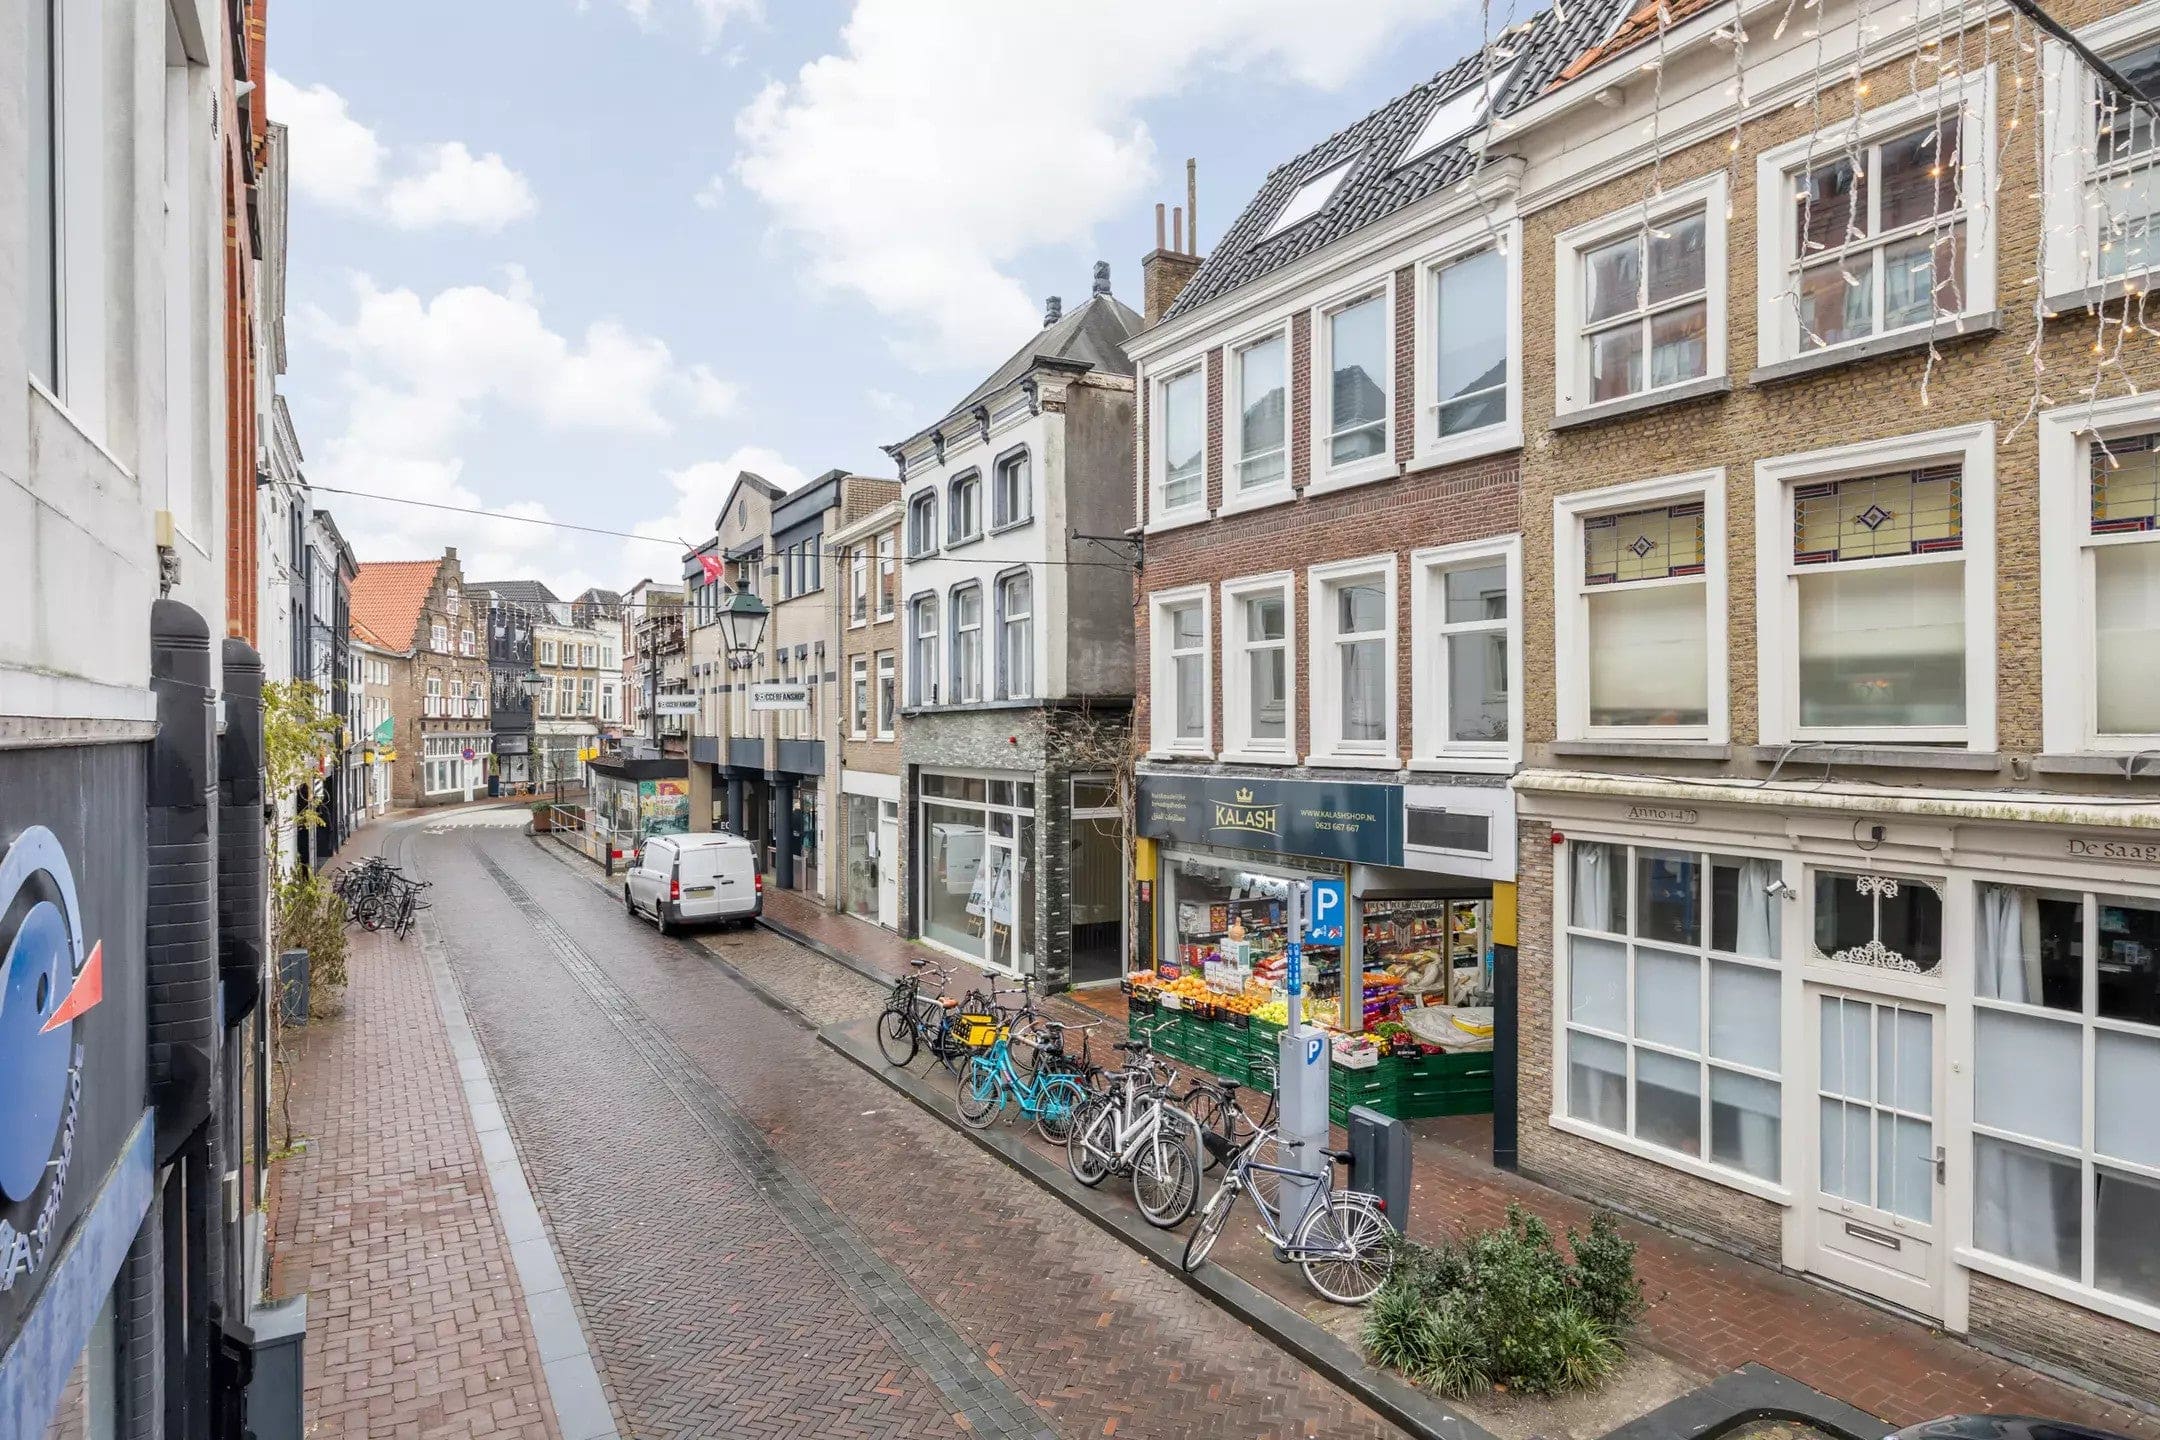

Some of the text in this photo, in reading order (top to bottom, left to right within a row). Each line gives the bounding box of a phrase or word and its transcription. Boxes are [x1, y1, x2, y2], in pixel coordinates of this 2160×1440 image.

[1215, 805, 1276, 831] KALASH
[1300, 809, 1377, 822] WWW.KALASHSHOP.NL
[1628, 806, 1667, 819] Anno
[2068, 839, 2160, 863] De Saag
[1317, 887, 1339, 921] P
[1308, 1040, 1320, 1059] P
